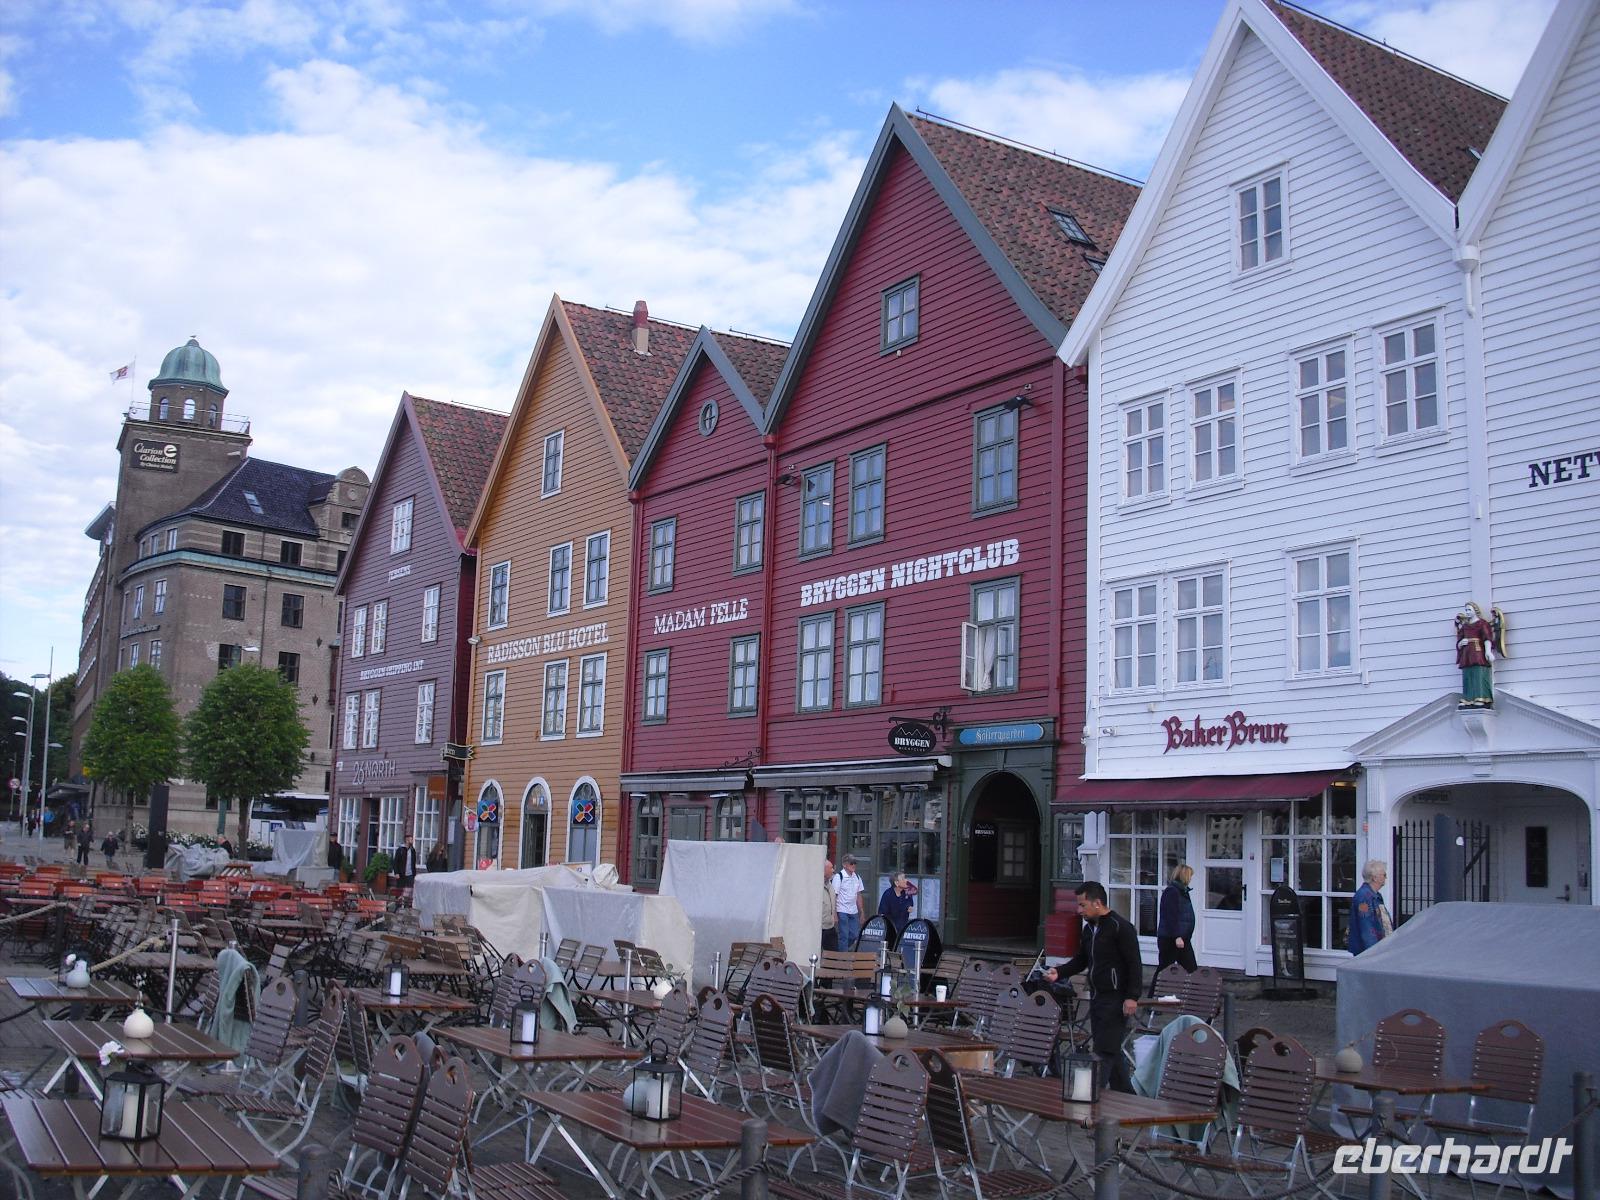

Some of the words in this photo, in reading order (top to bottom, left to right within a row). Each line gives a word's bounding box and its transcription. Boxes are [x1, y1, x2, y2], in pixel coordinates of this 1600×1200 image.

[134, 442, 163, 455] Clarion
[140, 453, 177, 465] Collection
[800, 567, 886, 607] BRYGGEN
[890, 538, 1020, 588] NIGHTCLUB
[653, 607, 705, 635] MADAM
[709, 598, 749, 624] FELLE
[487, 636, 541, 664] RADISSON
[542, 629, 566, 655] BLU
[567, 622, 609, 650] HOTEL
[894, 737, 930, 748] BRYGGEN
[352, 761, 365, 785] 26
